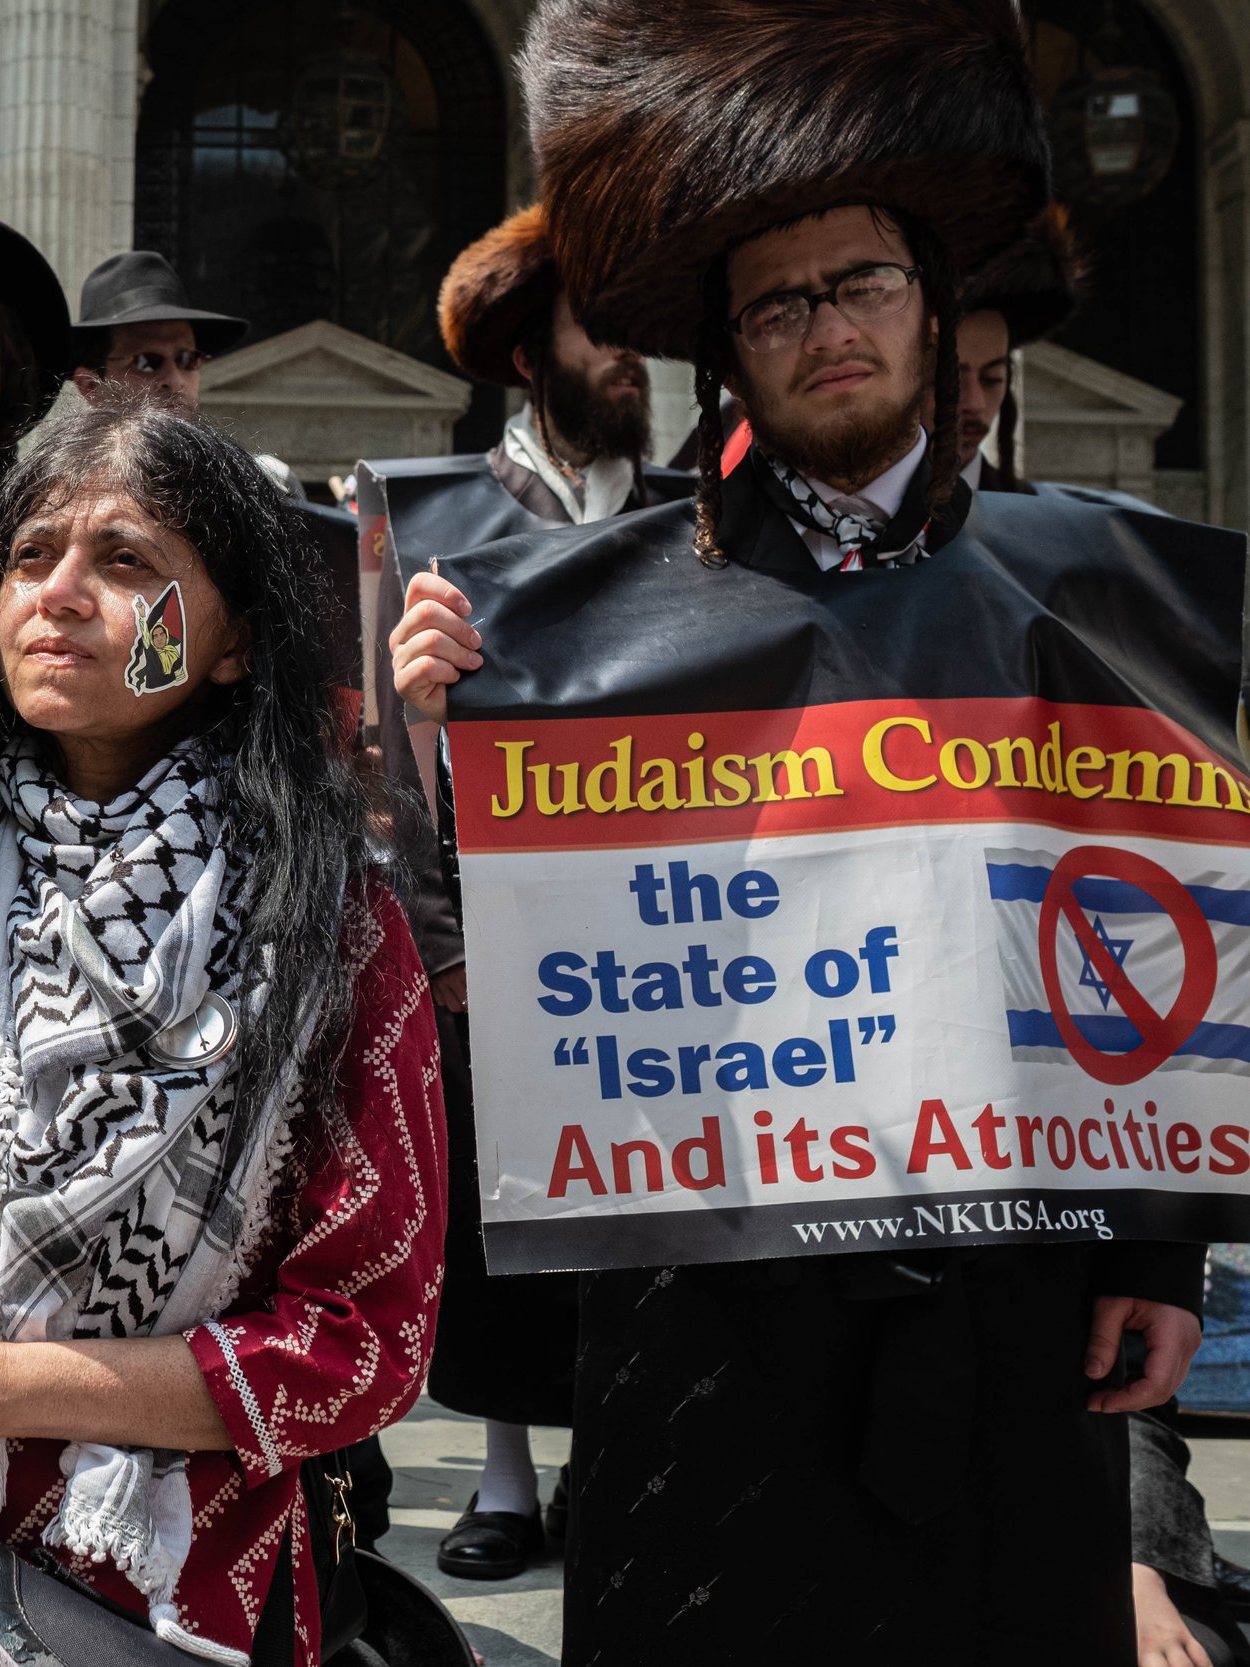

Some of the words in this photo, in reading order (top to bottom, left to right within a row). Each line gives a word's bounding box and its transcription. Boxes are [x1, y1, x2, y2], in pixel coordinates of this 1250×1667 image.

[492, 732, 843, 818] Judaism
[629, 860, 780, 926] the
[537, 944, 777, 1017] State
[804, 926, 899, 998] of
[547, 1116, 726, 1199] And
[753, 1110, 876, 1185] its
[907, 1099, 1250, 1175] Atrocities
[793, 1199, 1114, 1245] www.NKUSA.org
